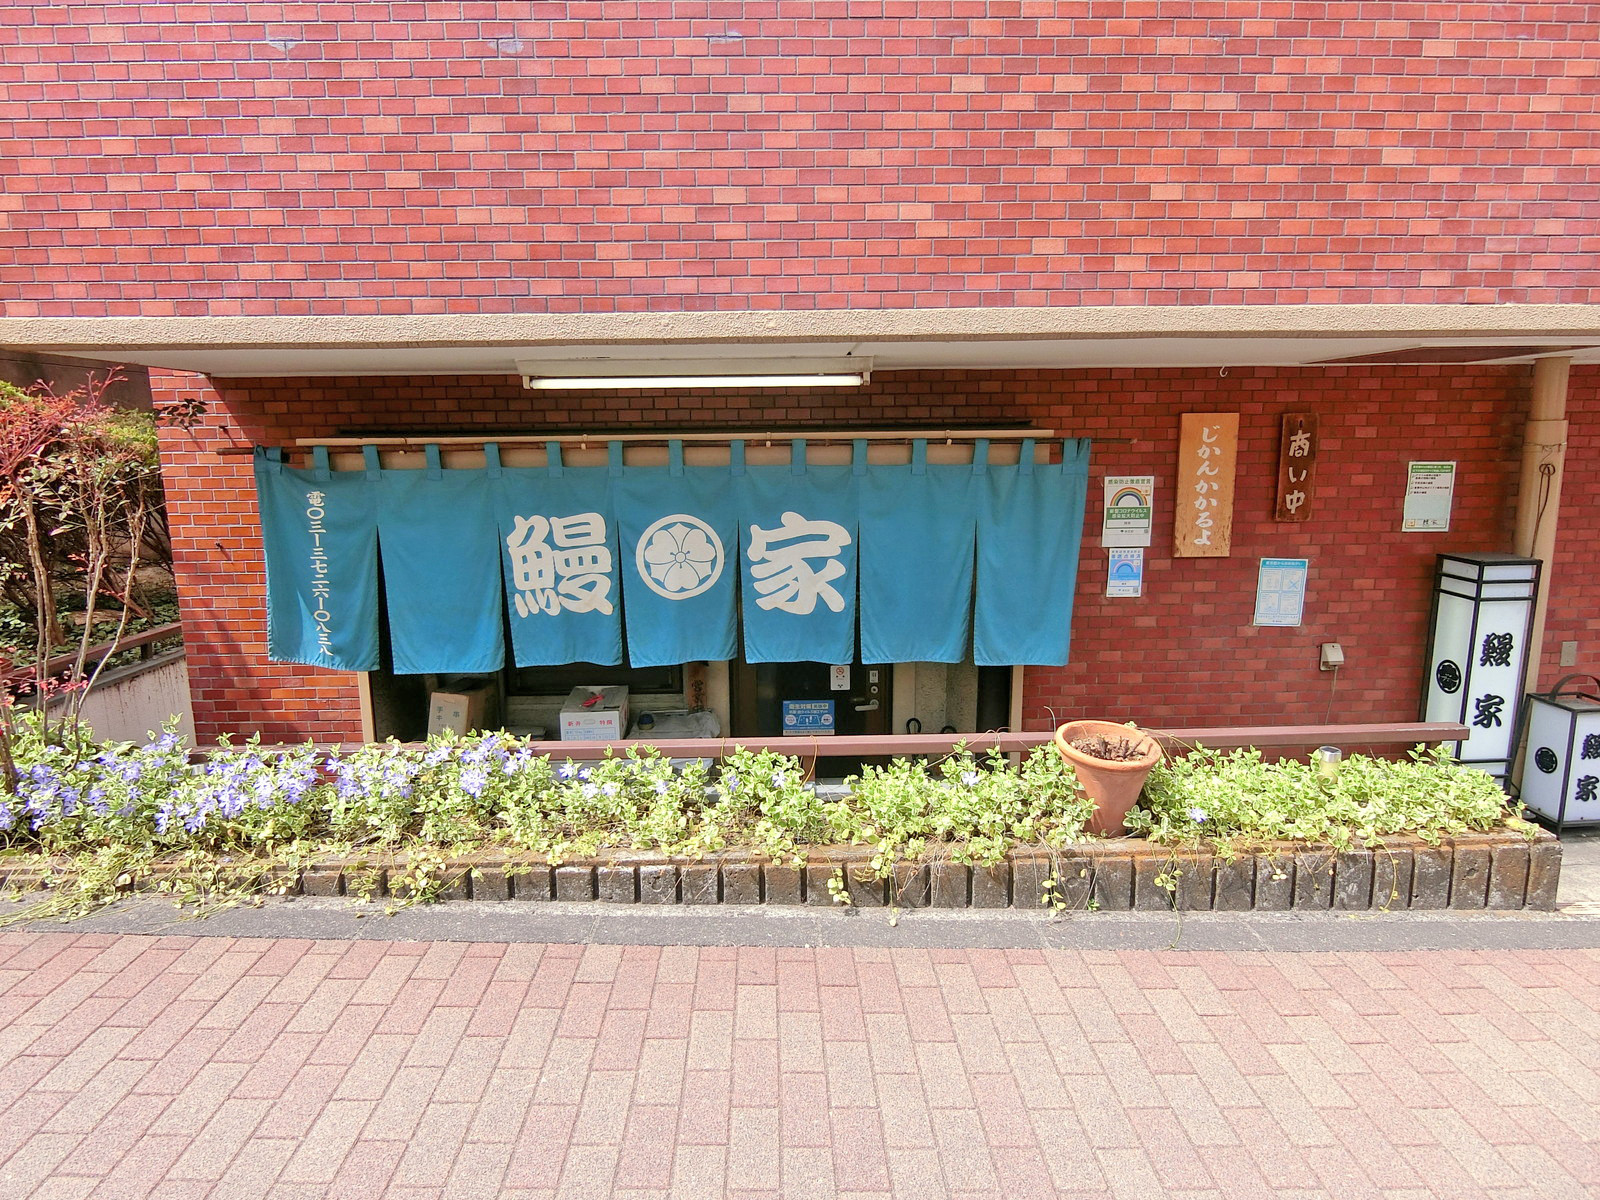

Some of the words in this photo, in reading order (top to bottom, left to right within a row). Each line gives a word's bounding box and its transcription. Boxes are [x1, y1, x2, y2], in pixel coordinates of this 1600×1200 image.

[1193, 425, 1221, 546] じかんかかるよ
[1285, 429, 1311, 514] 商い中
